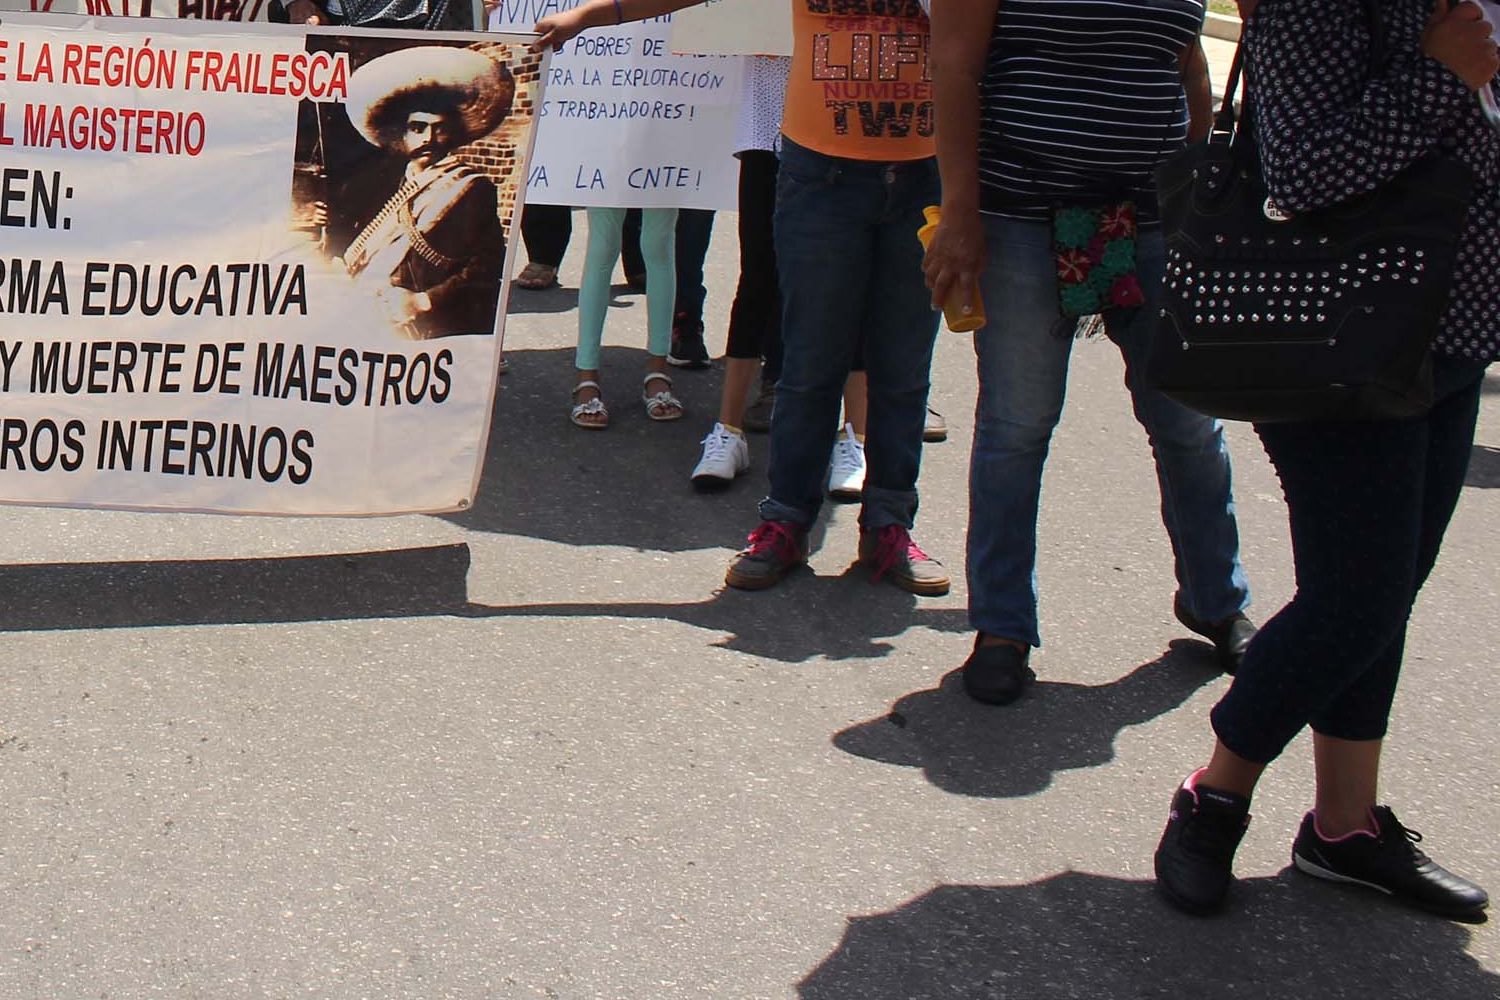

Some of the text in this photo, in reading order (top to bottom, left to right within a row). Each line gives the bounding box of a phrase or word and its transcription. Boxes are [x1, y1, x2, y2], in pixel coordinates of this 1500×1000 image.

[16, 41, 54, 83] LA
[62, 37, 177, 90] REGIÓN
[184, 49, 349, 99] FRAILESCA
[573, 35, 632, 57] POBRES
[641, 37, 666, 57] DE
[582, 67, 602, 87] LA
[611, 67, 725, 90] EXPLOTACIÓN
[823, 82, 932, 100] NUMBE
[23, 103, 206, 157] MAGISTERIO
[575, 164, 605, 190] LA
[627, 165, 702, 191] CNTE!
[80, 262, 308, 317] EDUCATIVA
[29, 341, 186, 395] MUERTE
[192, 342, 243, 394] DE
[252, 342, 454, 407] MAESTROS
[97, 419, 316, 487] INTERINOS
